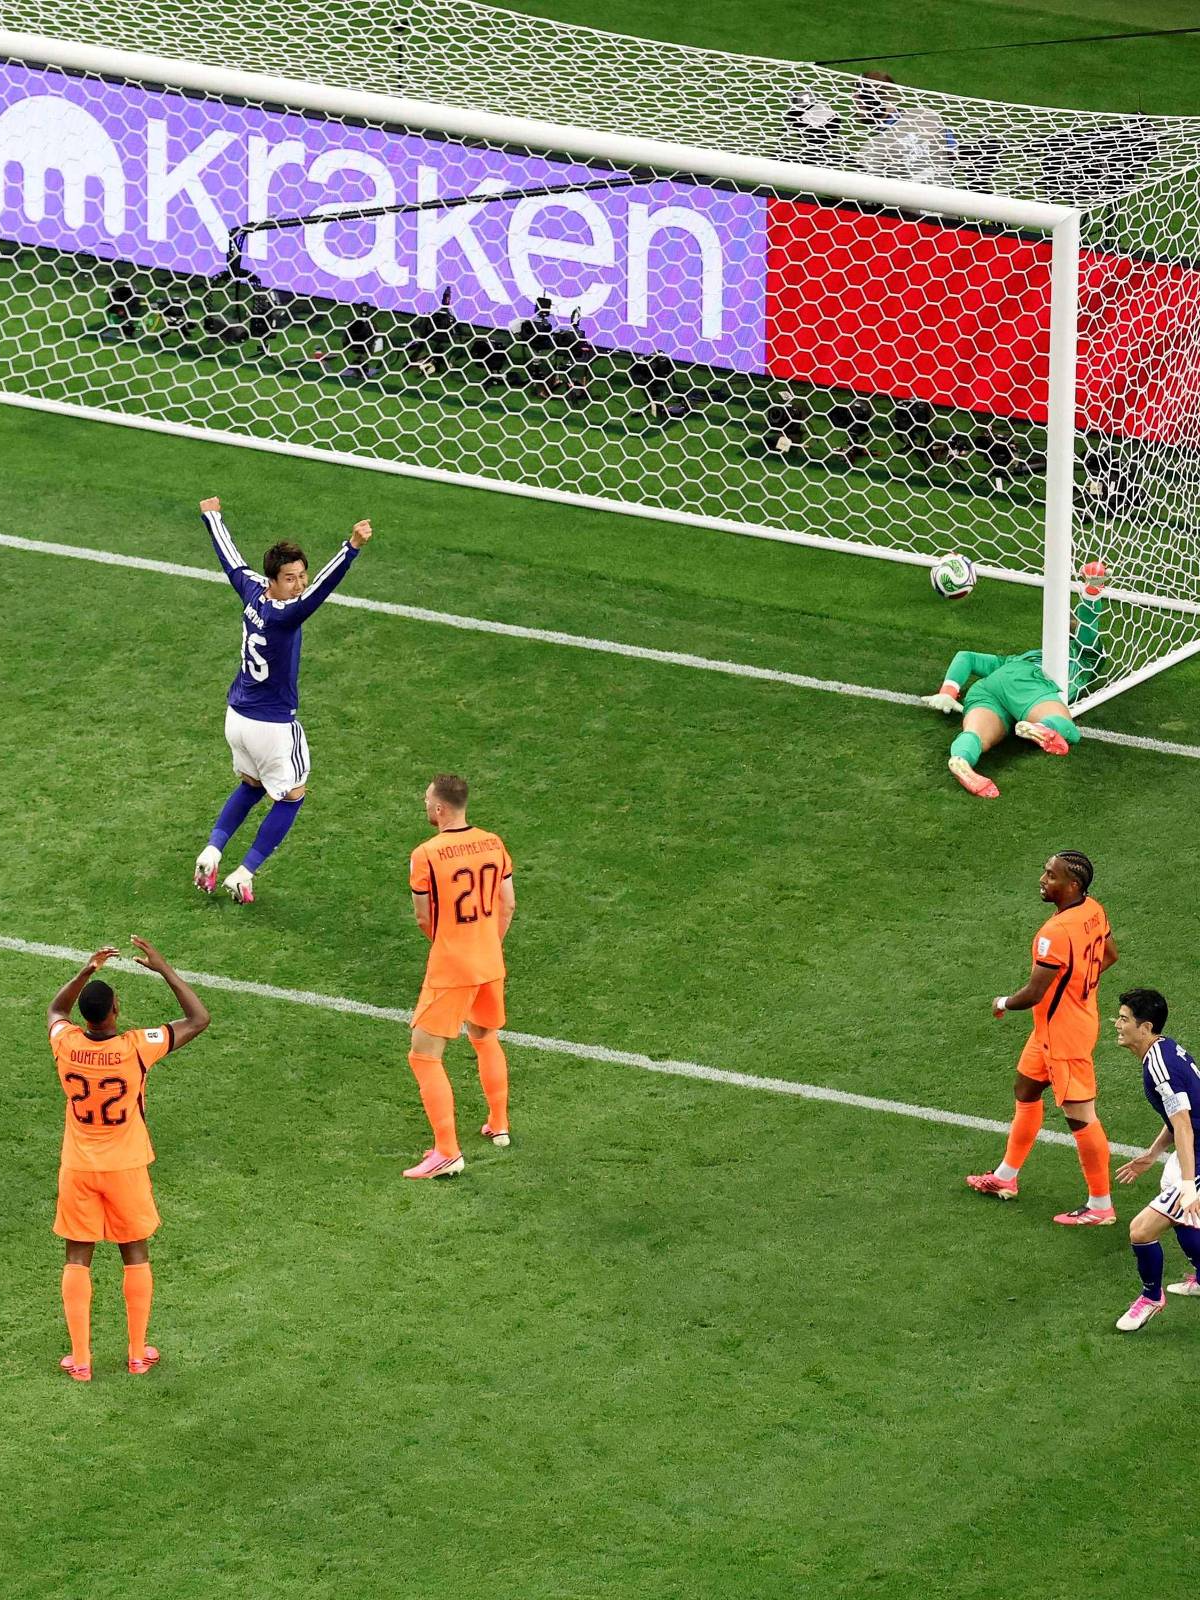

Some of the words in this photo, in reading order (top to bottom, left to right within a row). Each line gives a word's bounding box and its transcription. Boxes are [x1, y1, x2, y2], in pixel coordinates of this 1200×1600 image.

[146, 116, 724, 341] kraken
[241, 621, 269, 682] 15
[452, 863, 498, 925] 20
[70, 1049, 121, 1066] DUMFRIES
[65, 1072, 127, 1125] 22
